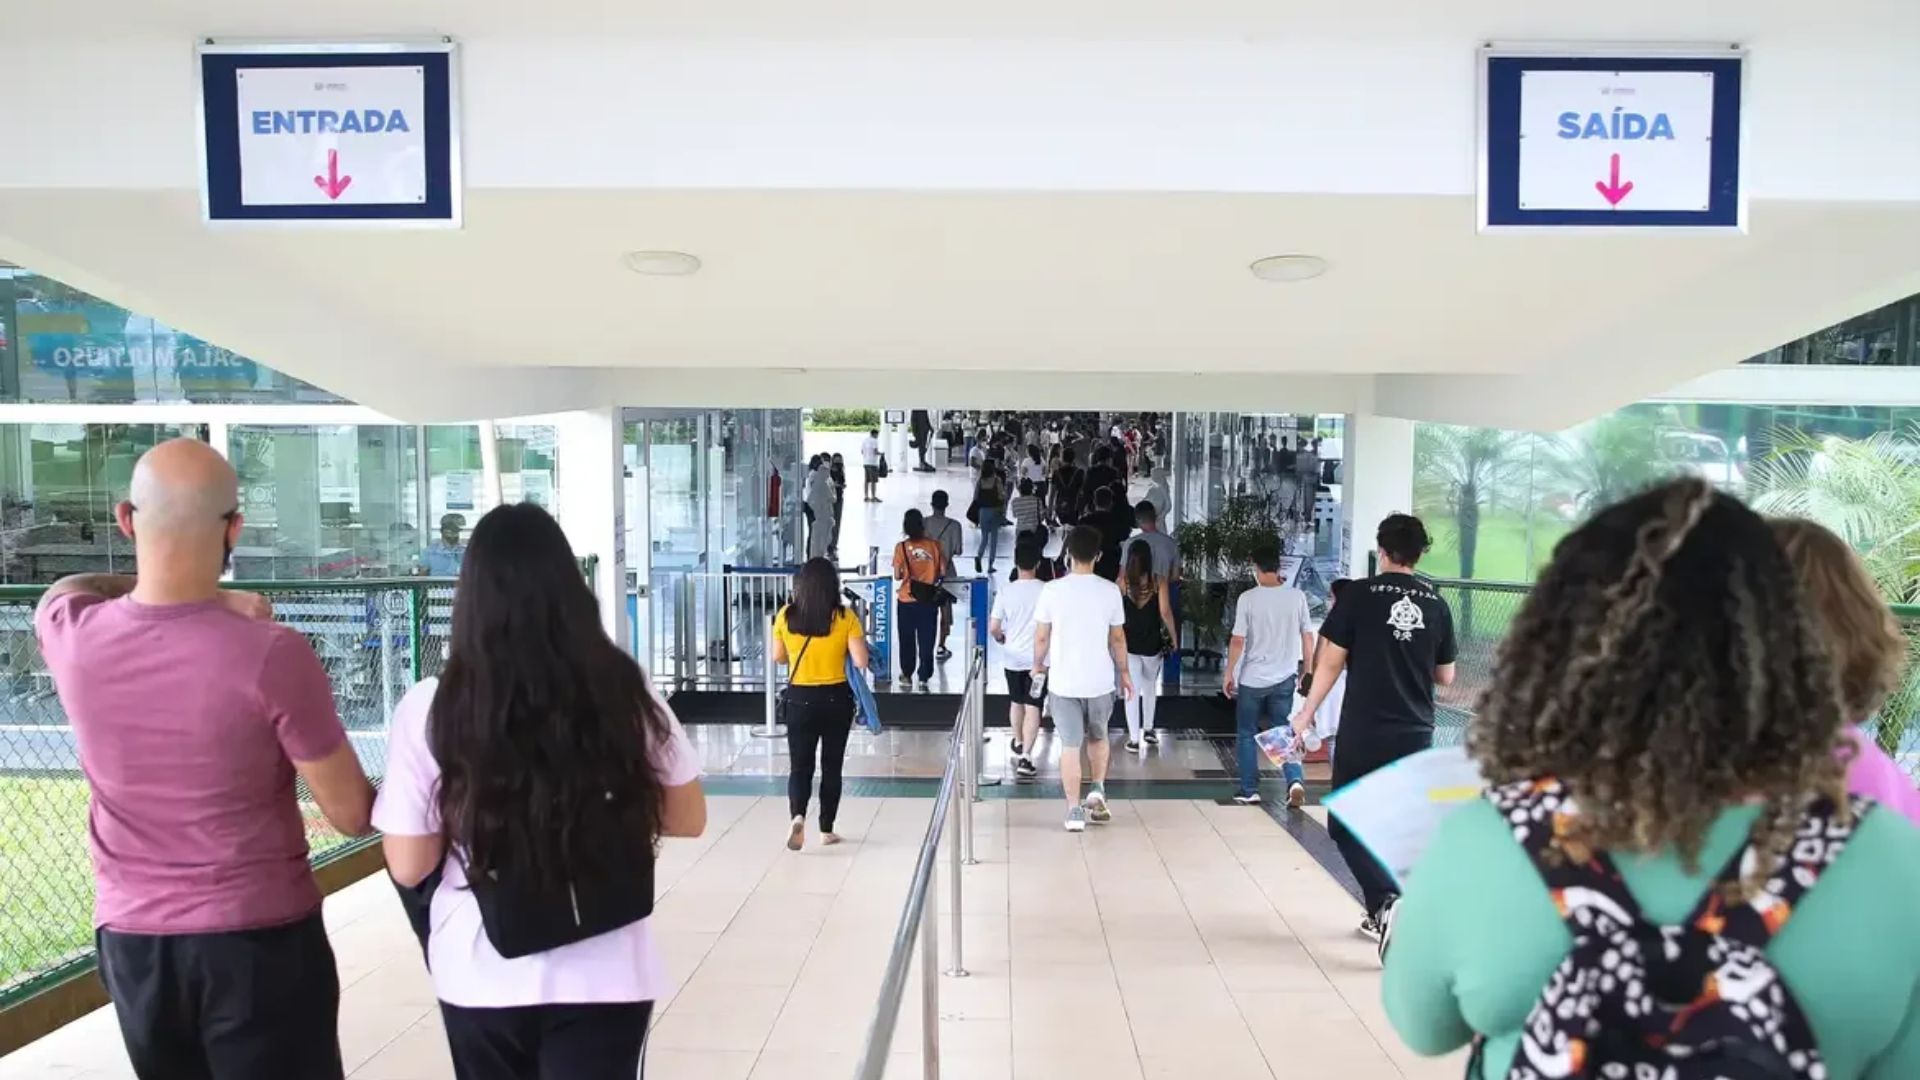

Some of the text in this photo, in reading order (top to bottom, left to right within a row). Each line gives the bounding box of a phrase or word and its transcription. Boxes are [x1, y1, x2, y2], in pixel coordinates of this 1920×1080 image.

[252, 109, 410, 134] ENTRADA
[1557, 106, 1675, 140] SAÍDA
[876, 585, 886, 642] ENTRADA
